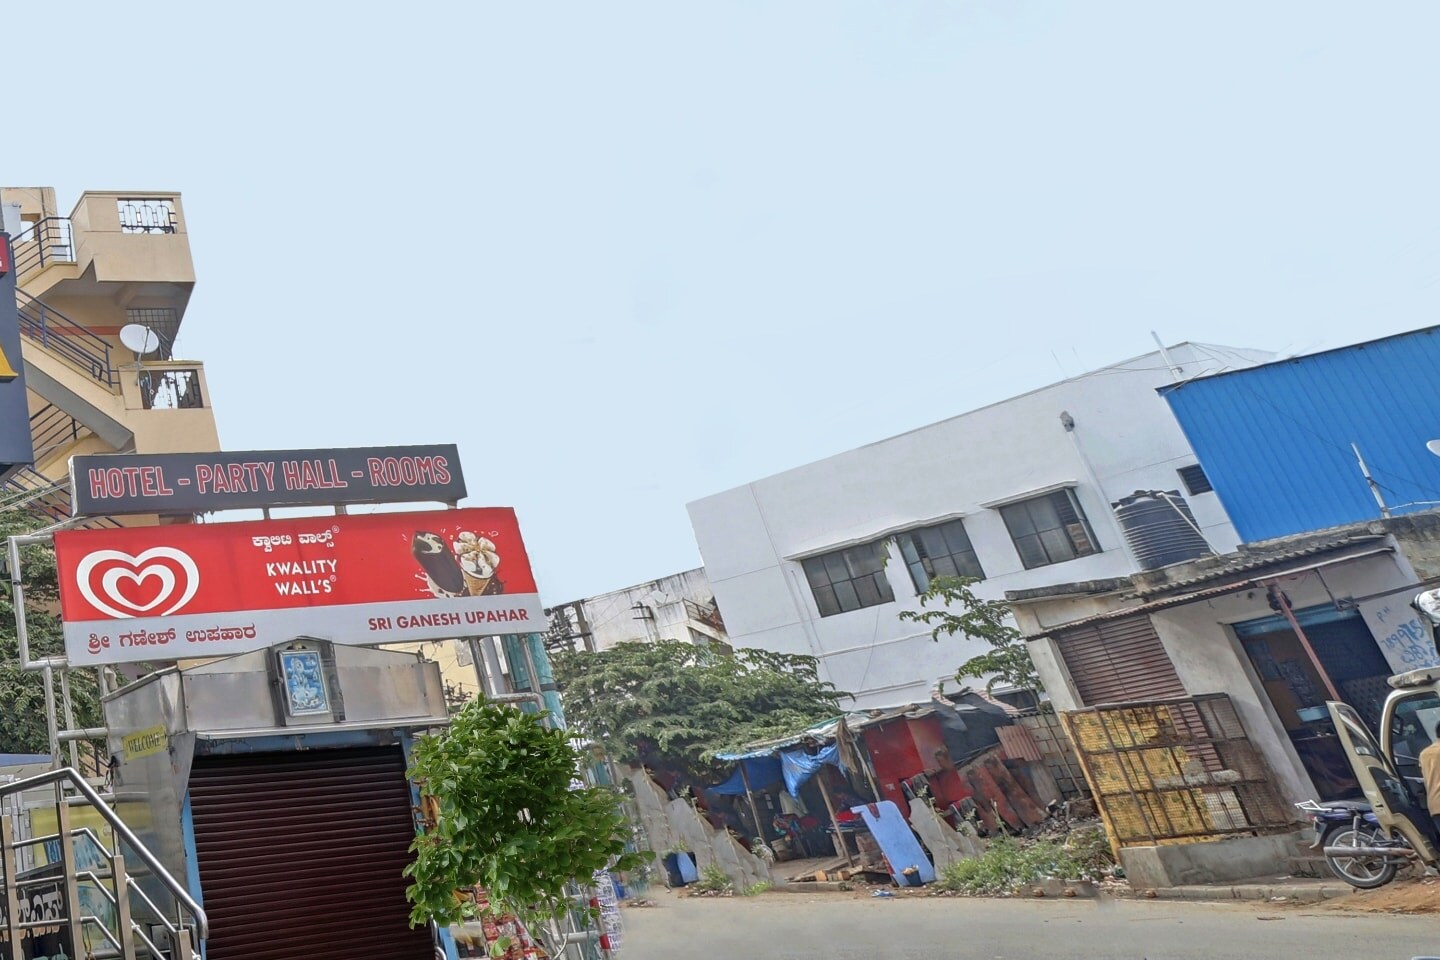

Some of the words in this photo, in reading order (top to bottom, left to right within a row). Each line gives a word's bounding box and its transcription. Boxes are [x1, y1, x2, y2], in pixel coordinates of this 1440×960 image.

[88, 466, 174, 499] HOTEL
[196, 461, 277, 494] PARTY
[283, 458, 348, 491] HALL
[367, 455, 452, 487] ROOMS
[266, 558, 338, 577] KWALITY
[275, 578, 333, 596] WALL'S
[367, 616, 393, 632] SRI
[395, 612, 461, 630] GANESH
[464, 607, 529, 626] UPAHAR
[87, 633, 111, 655] ಶ್ರೀ
[185, 622, 257, 644] ಉಪಹಾರ
[127, 732, 162, 753] WELCOME
